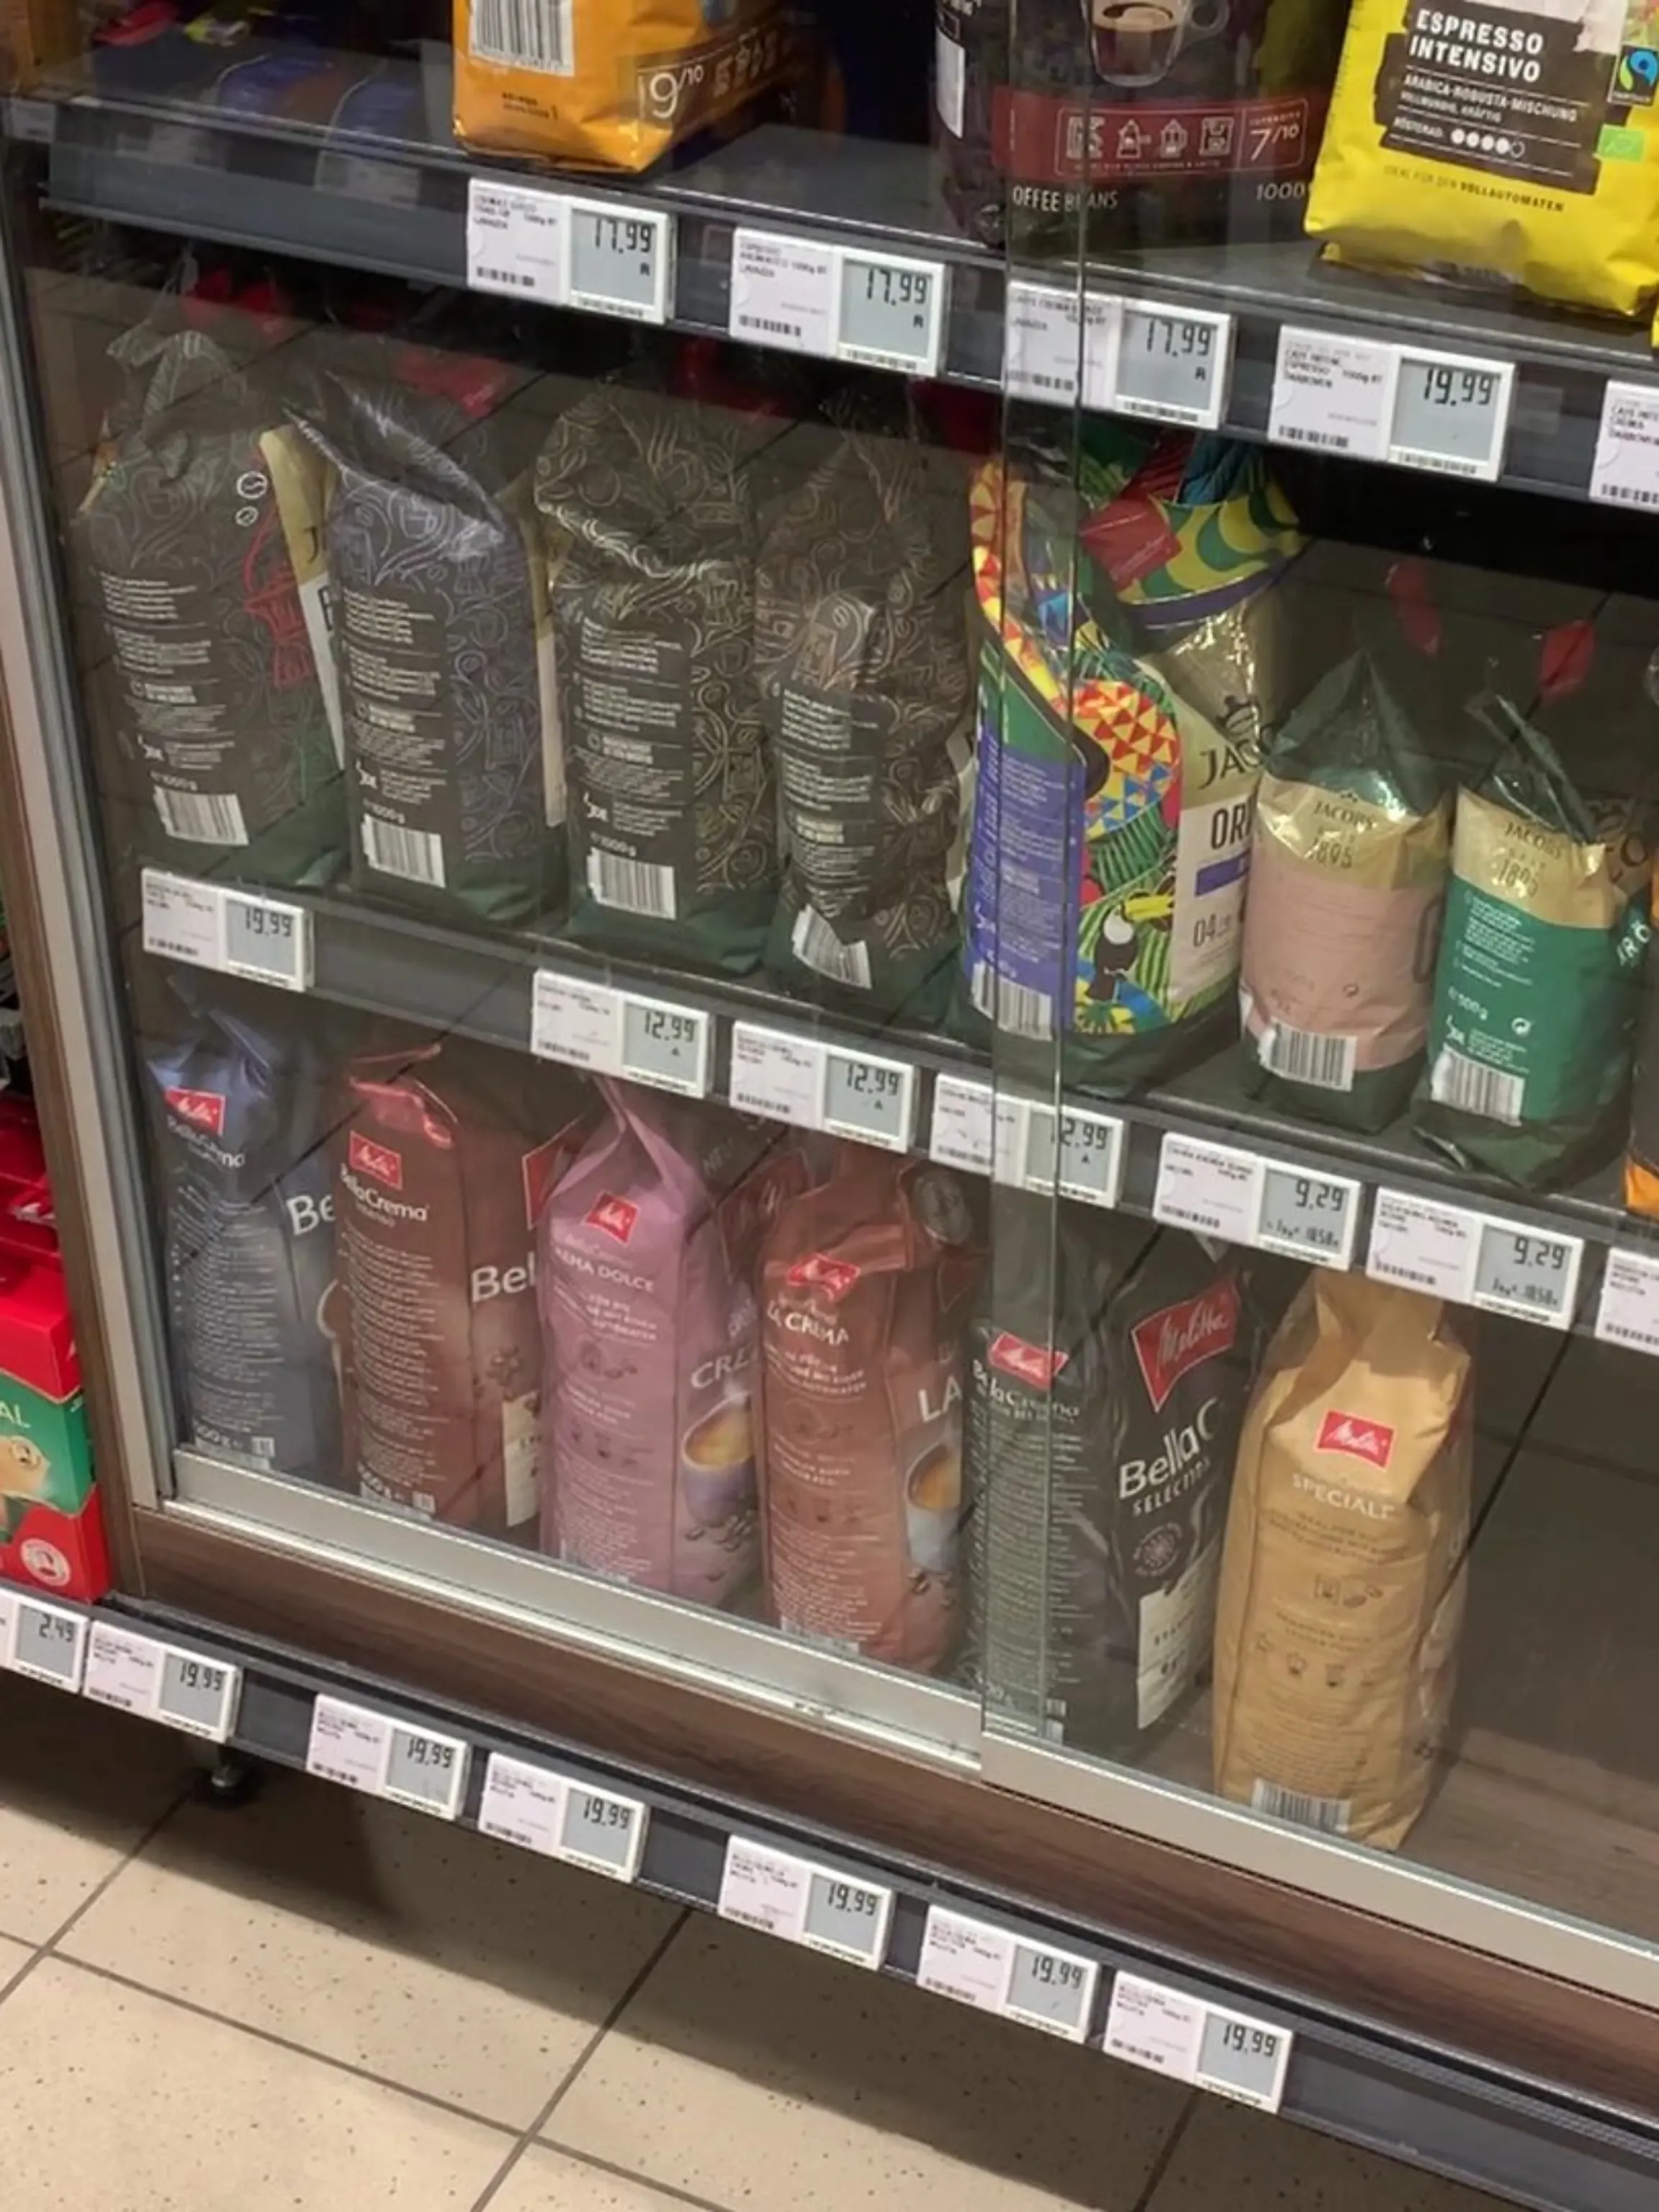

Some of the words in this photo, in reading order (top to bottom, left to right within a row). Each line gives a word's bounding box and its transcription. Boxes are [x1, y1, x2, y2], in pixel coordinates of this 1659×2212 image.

[1416, 8, 1545, 55] ESPRESSO
[1409, 35, 1542, 83] INTENSIVO
[1012, 185, 1061, 212] OFFEE
[595, 217, 653, 254] 17.99
[867, 268, 927, 306] 17.99
[1146, 319, 1211, 357] 17.99
[1423, 367, 1493, 407] 19.99
[245, 906, 292, 938] 19.99
[644, 1008, 696, 1042] 12.99
[847, 1063, 899, 1096] 12.99
[1295, 1178, 1344, 1211] 9.29
[1514, 1236, 1565, 1269] 9.29
[596, 1265, 655, 1292] DOLCE
[179, 1660, 223, 1692] 19.99
[406, 1736, 452, 1768] 19.99
[583, 1794, 631, 1830] 19.99
[827, 1883, 878, 1916] 19.99
[1031, 1954, 1083, 1990] 19.99
[1223, 2023, 1277, 2057] 19.99
